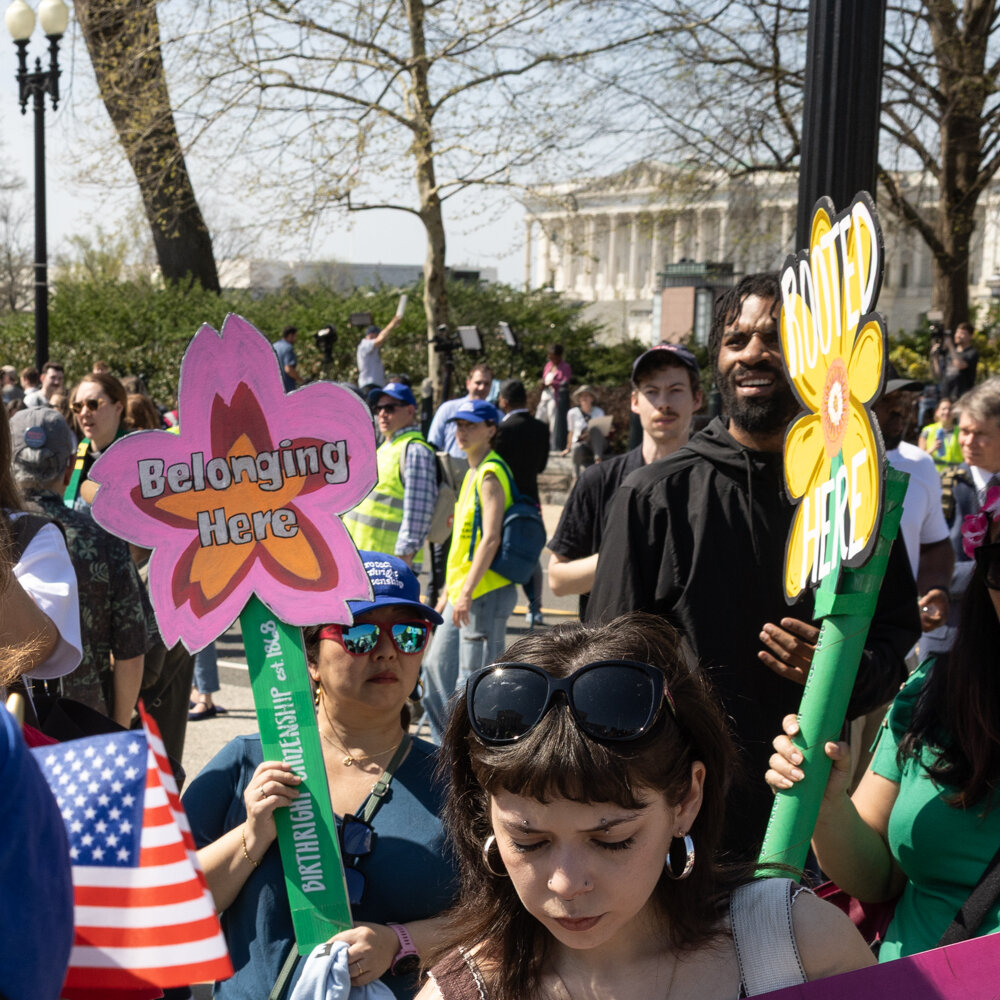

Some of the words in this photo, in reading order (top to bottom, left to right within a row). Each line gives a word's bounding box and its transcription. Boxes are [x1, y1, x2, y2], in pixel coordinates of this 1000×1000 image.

[781, 201, 878, 378] ROOTED
[137, 439, 350, 499] Belonging
[801, 448, 867, 589] HERE
[197, 507, 299, 548] Here
